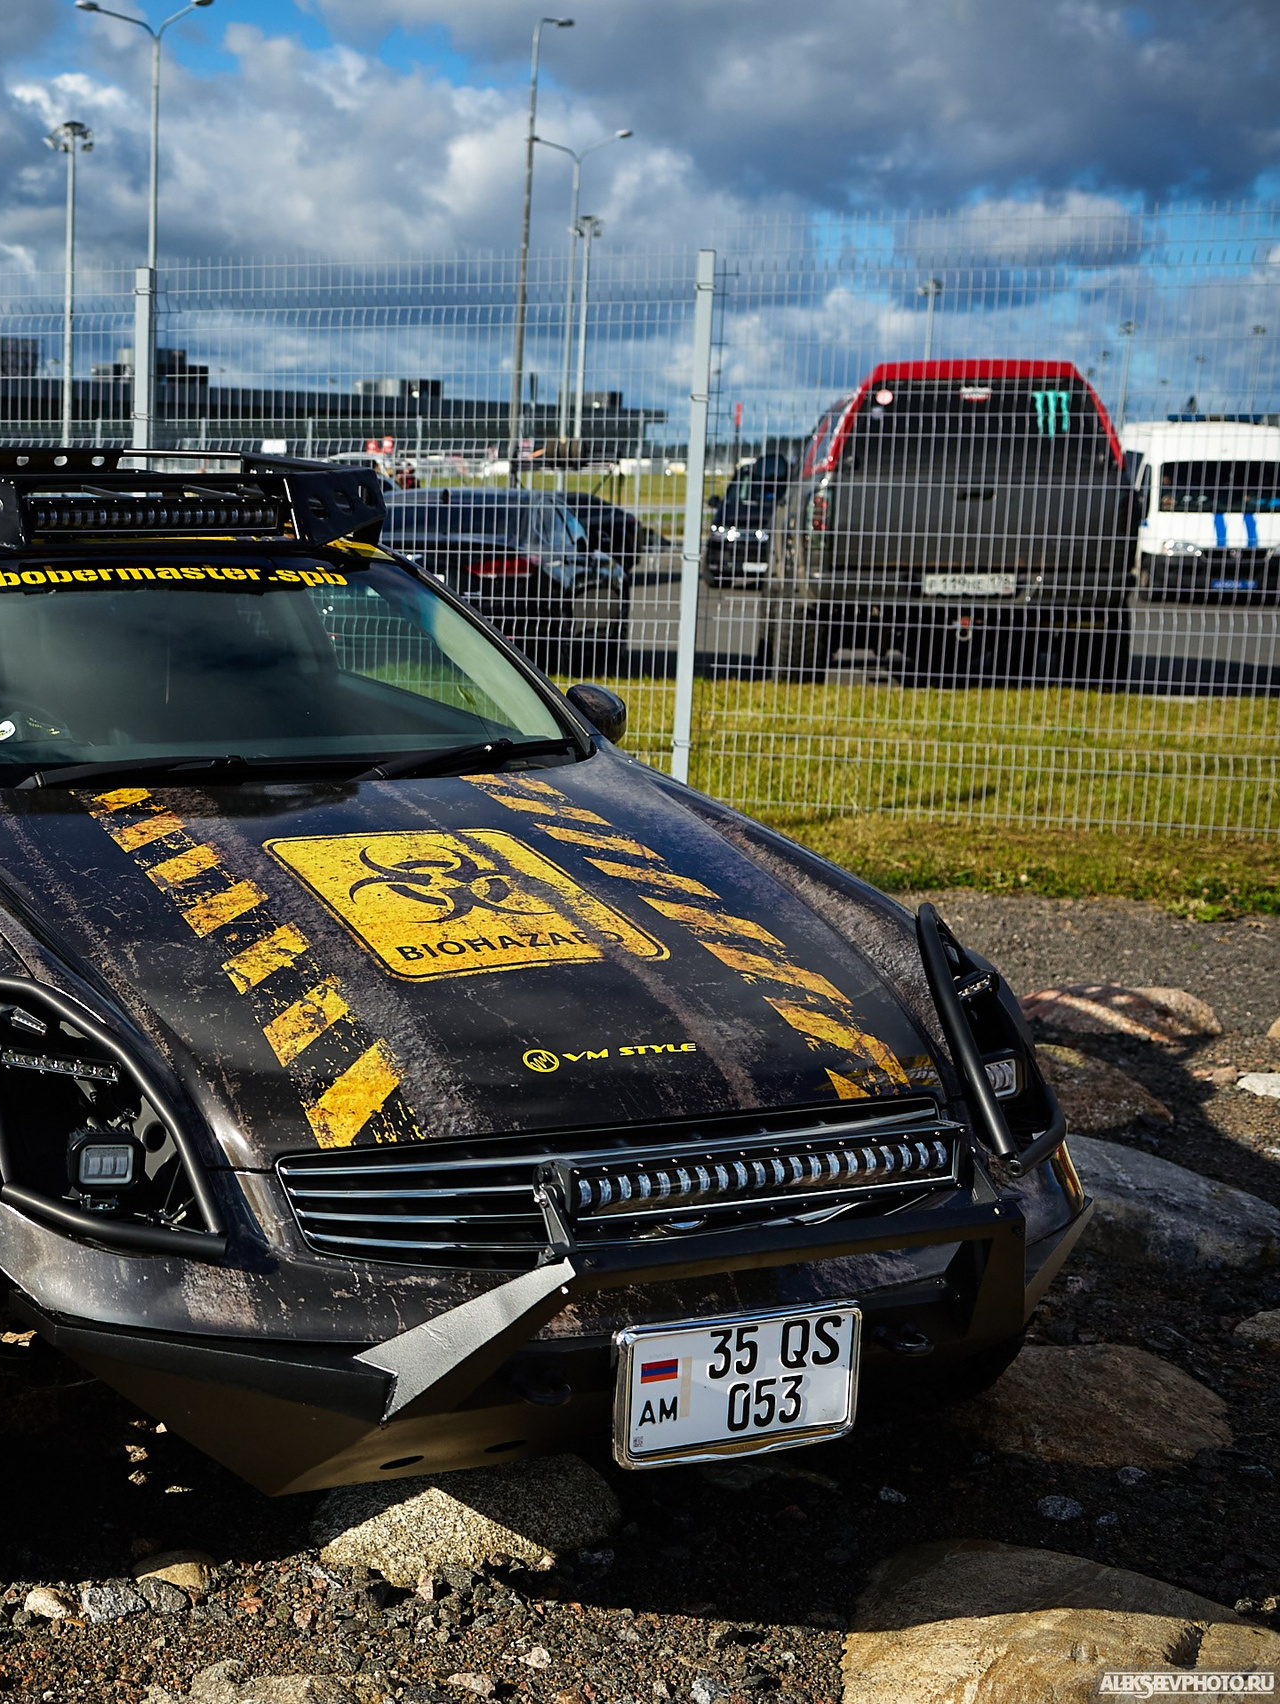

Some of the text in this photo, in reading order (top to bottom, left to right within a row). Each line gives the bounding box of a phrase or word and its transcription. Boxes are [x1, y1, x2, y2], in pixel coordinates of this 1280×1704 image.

[562, 1048, 609, 1062] VM
[619, 1042, 696, 1056] STYLE
[708, 1315, 842, 1379] 35 QS
[638, 1396, 678, 1427] AM
[727, 1375, 803, 1432] 053
